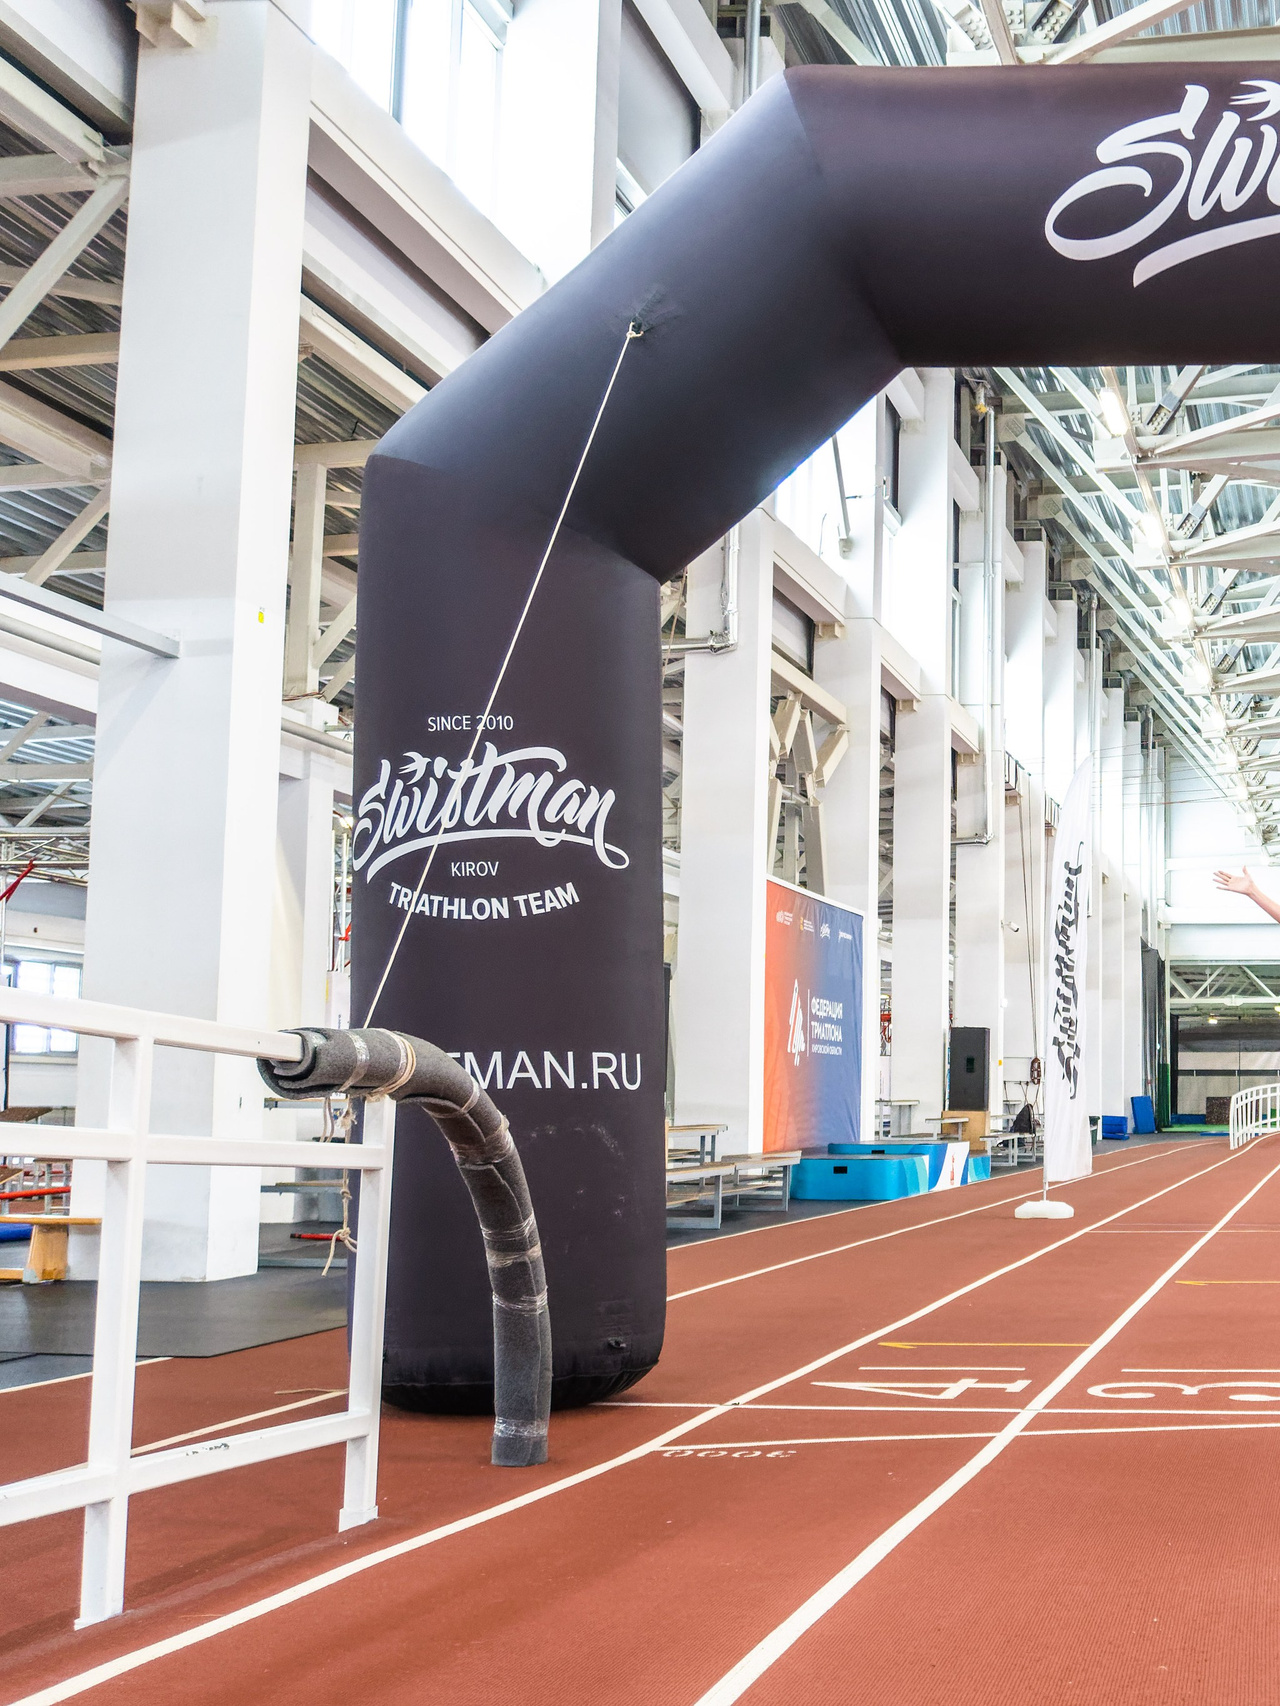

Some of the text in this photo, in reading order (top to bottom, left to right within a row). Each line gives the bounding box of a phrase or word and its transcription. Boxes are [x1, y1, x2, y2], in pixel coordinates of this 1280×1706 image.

[427, 714, 514, 732] SINCE 2010
[451, 861, 499, 877] KIROV
[388, 881, 580, 920] TRIATHLON TEAM
[811, 996, 843, 1021] ФЕДЕРАЦИЯ
[811, 1021, 843, 1042] ТРИАТЛОНА
[810, 1378, 1033, 1400] 4
